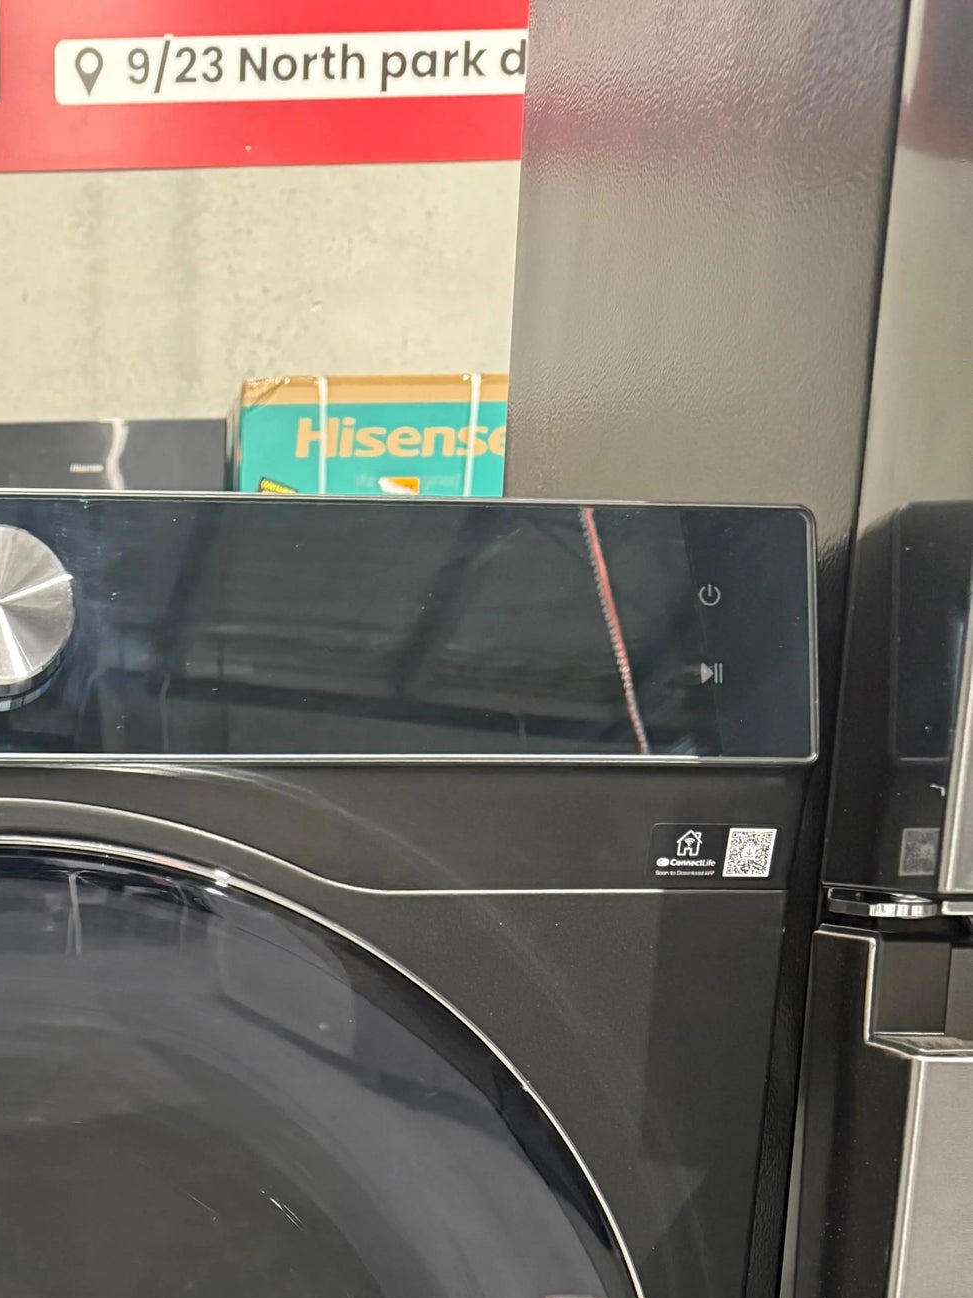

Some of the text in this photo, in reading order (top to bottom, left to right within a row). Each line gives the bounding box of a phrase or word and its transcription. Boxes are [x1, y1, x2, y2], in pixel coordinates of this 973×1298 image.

[128, 40, 224, 94] 9/23
[239, 43, 365, 82] North
[381, 40, 487, 92] park
